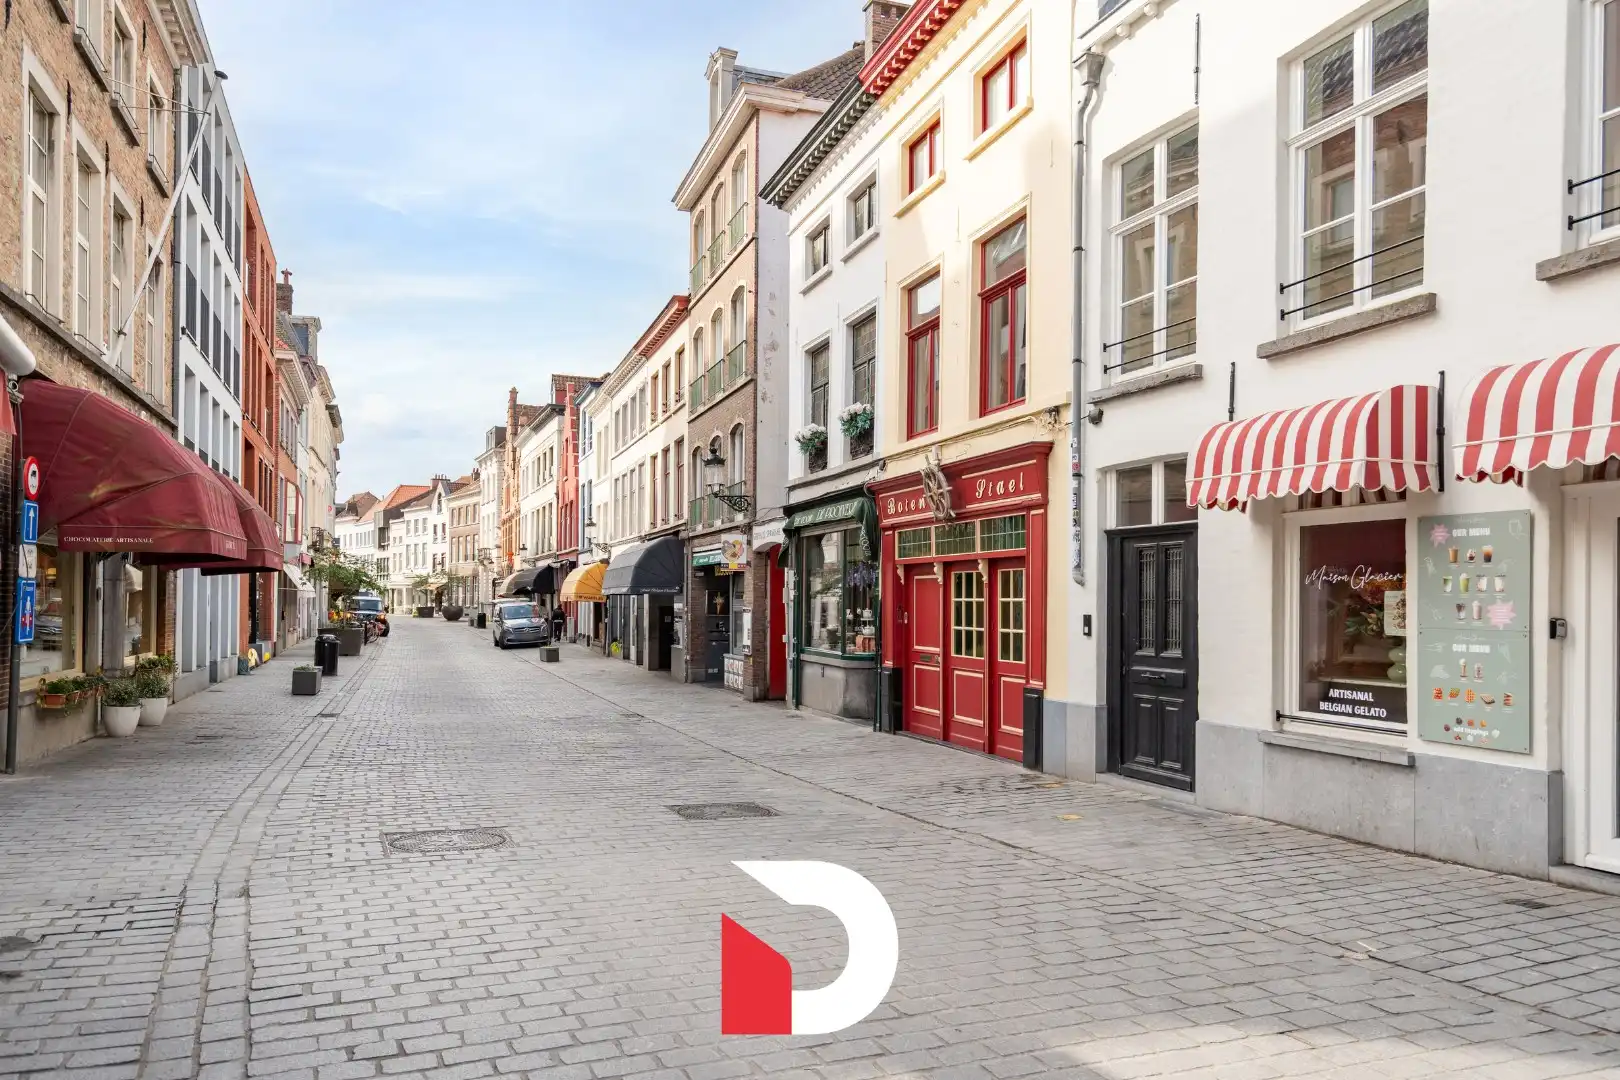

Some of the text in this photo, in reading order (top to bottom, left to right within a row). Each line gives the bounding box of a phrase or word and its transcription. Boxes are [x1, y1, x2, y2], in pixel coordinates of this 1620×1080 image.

[887, 472, 1024, 515] Boten Stael
[1452, 528, 1467, 537] OUR
[1468, 527, 1491, 537] MENU
[1305, 564, 1403, 590] Maison Glacier
[1452, 643, 1491, 653] OUR MENU
[1328, 688, 1374, 702] ARTISANAL
[1319, 701, 1387, 718] BELGIAN GELATO
